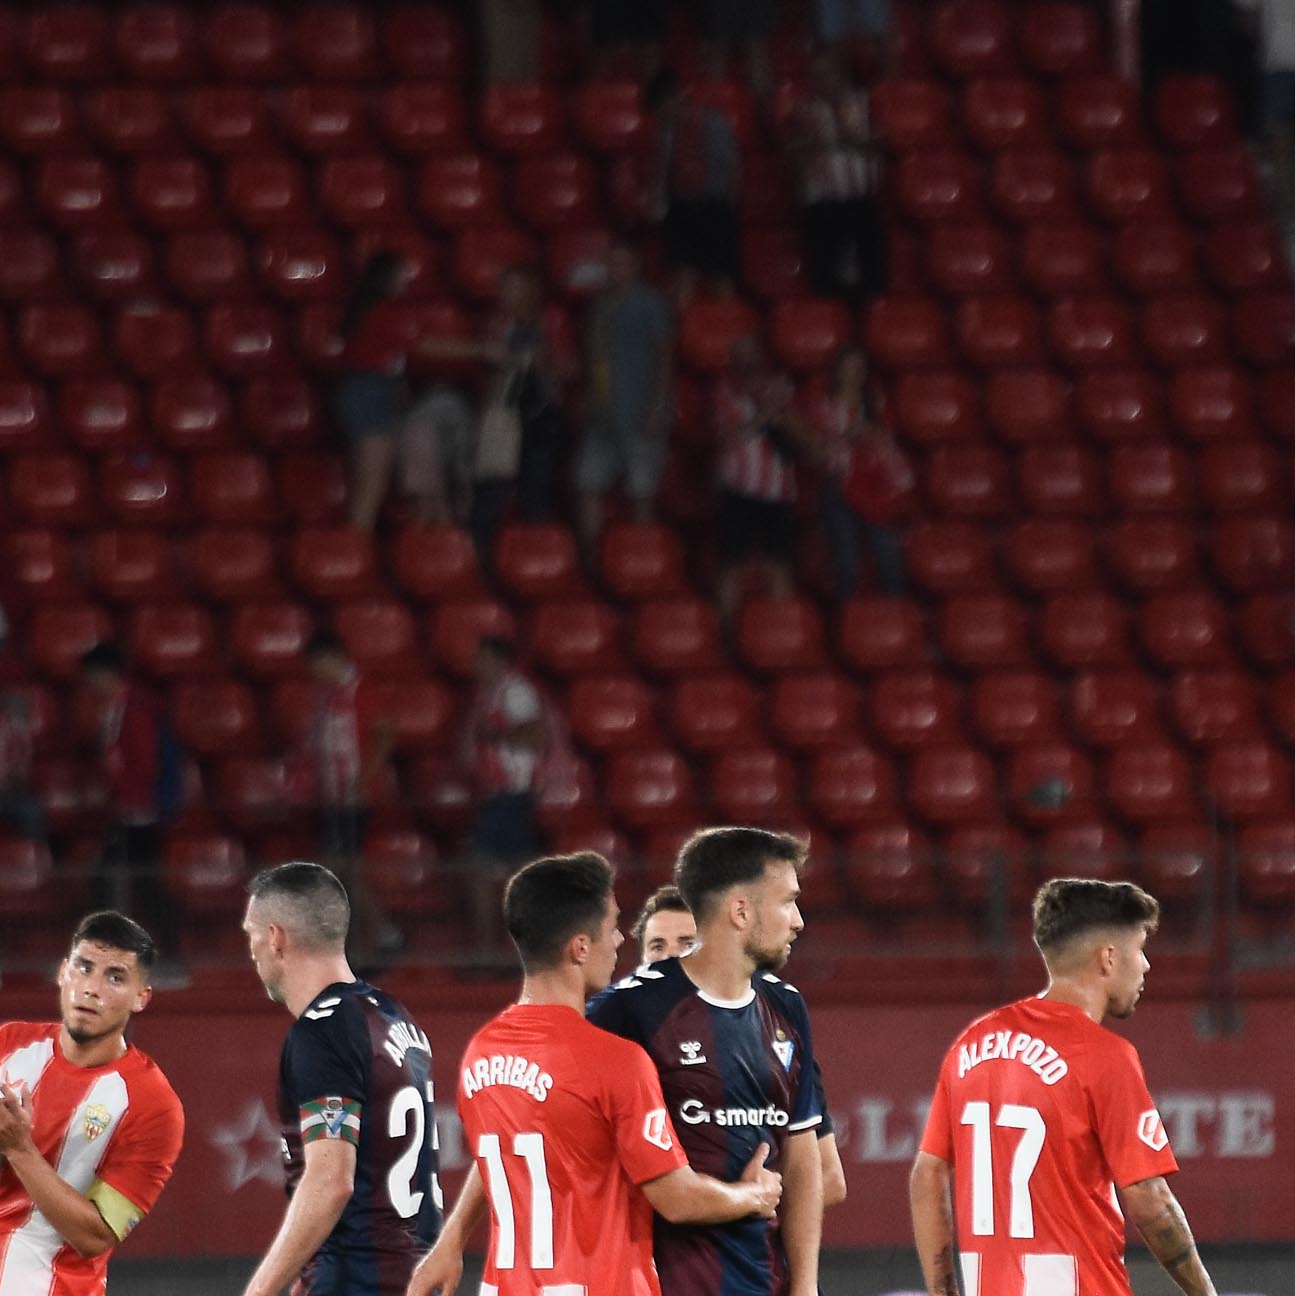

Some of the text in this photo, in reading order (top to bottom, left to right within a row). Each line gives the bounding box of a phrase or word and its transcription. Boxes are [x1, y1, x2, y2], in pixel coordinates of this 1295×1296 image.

[463, 1055, 553, 1103] ARRIBAS
[958, 1030, 1069, 1086] ALEXPOZO
[478, 1133, 554, 1270] 11
[960, 1102, 1047, 1238] 17
